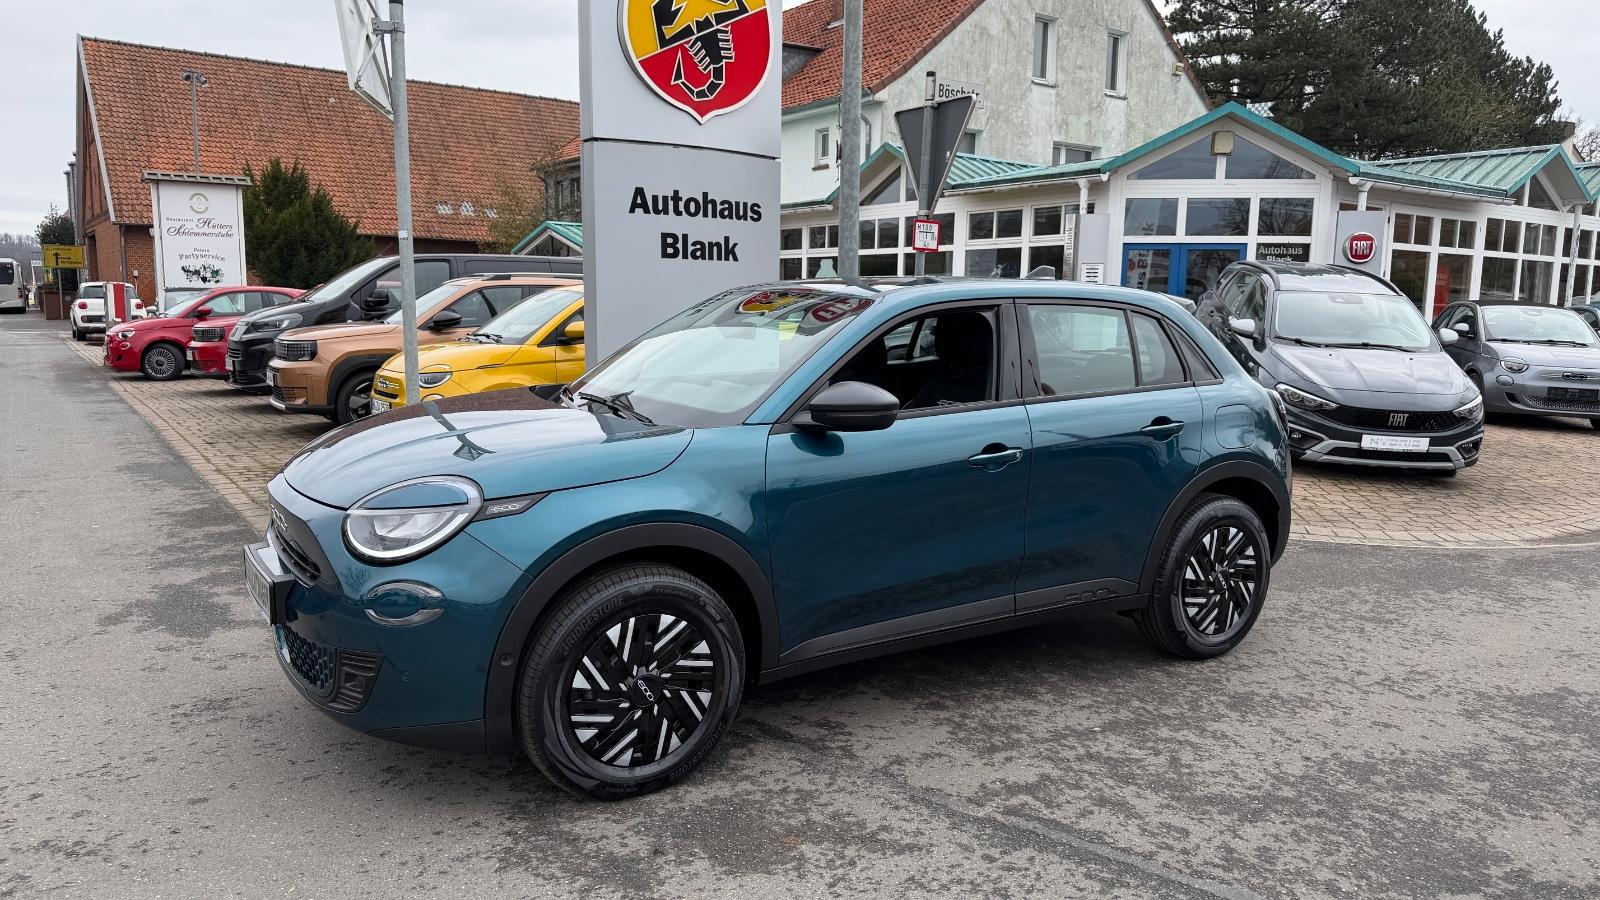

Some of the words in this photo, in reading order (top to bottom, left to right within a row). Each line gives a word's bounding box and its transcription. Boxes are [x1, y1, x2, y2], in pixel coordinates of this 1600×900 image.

[628, 186, 762, 222] Autohaus
[167, 223, 234, 239] Schlemmerstube
[660, 231, 739, 262] Blank
[1258, 245, 1304, 255] Autohaus
[1352, 240, 1372, 256] FIAT
[178, 252, 226, 262] Partyservice
[1387, 413, 1410, 427] FIAT
